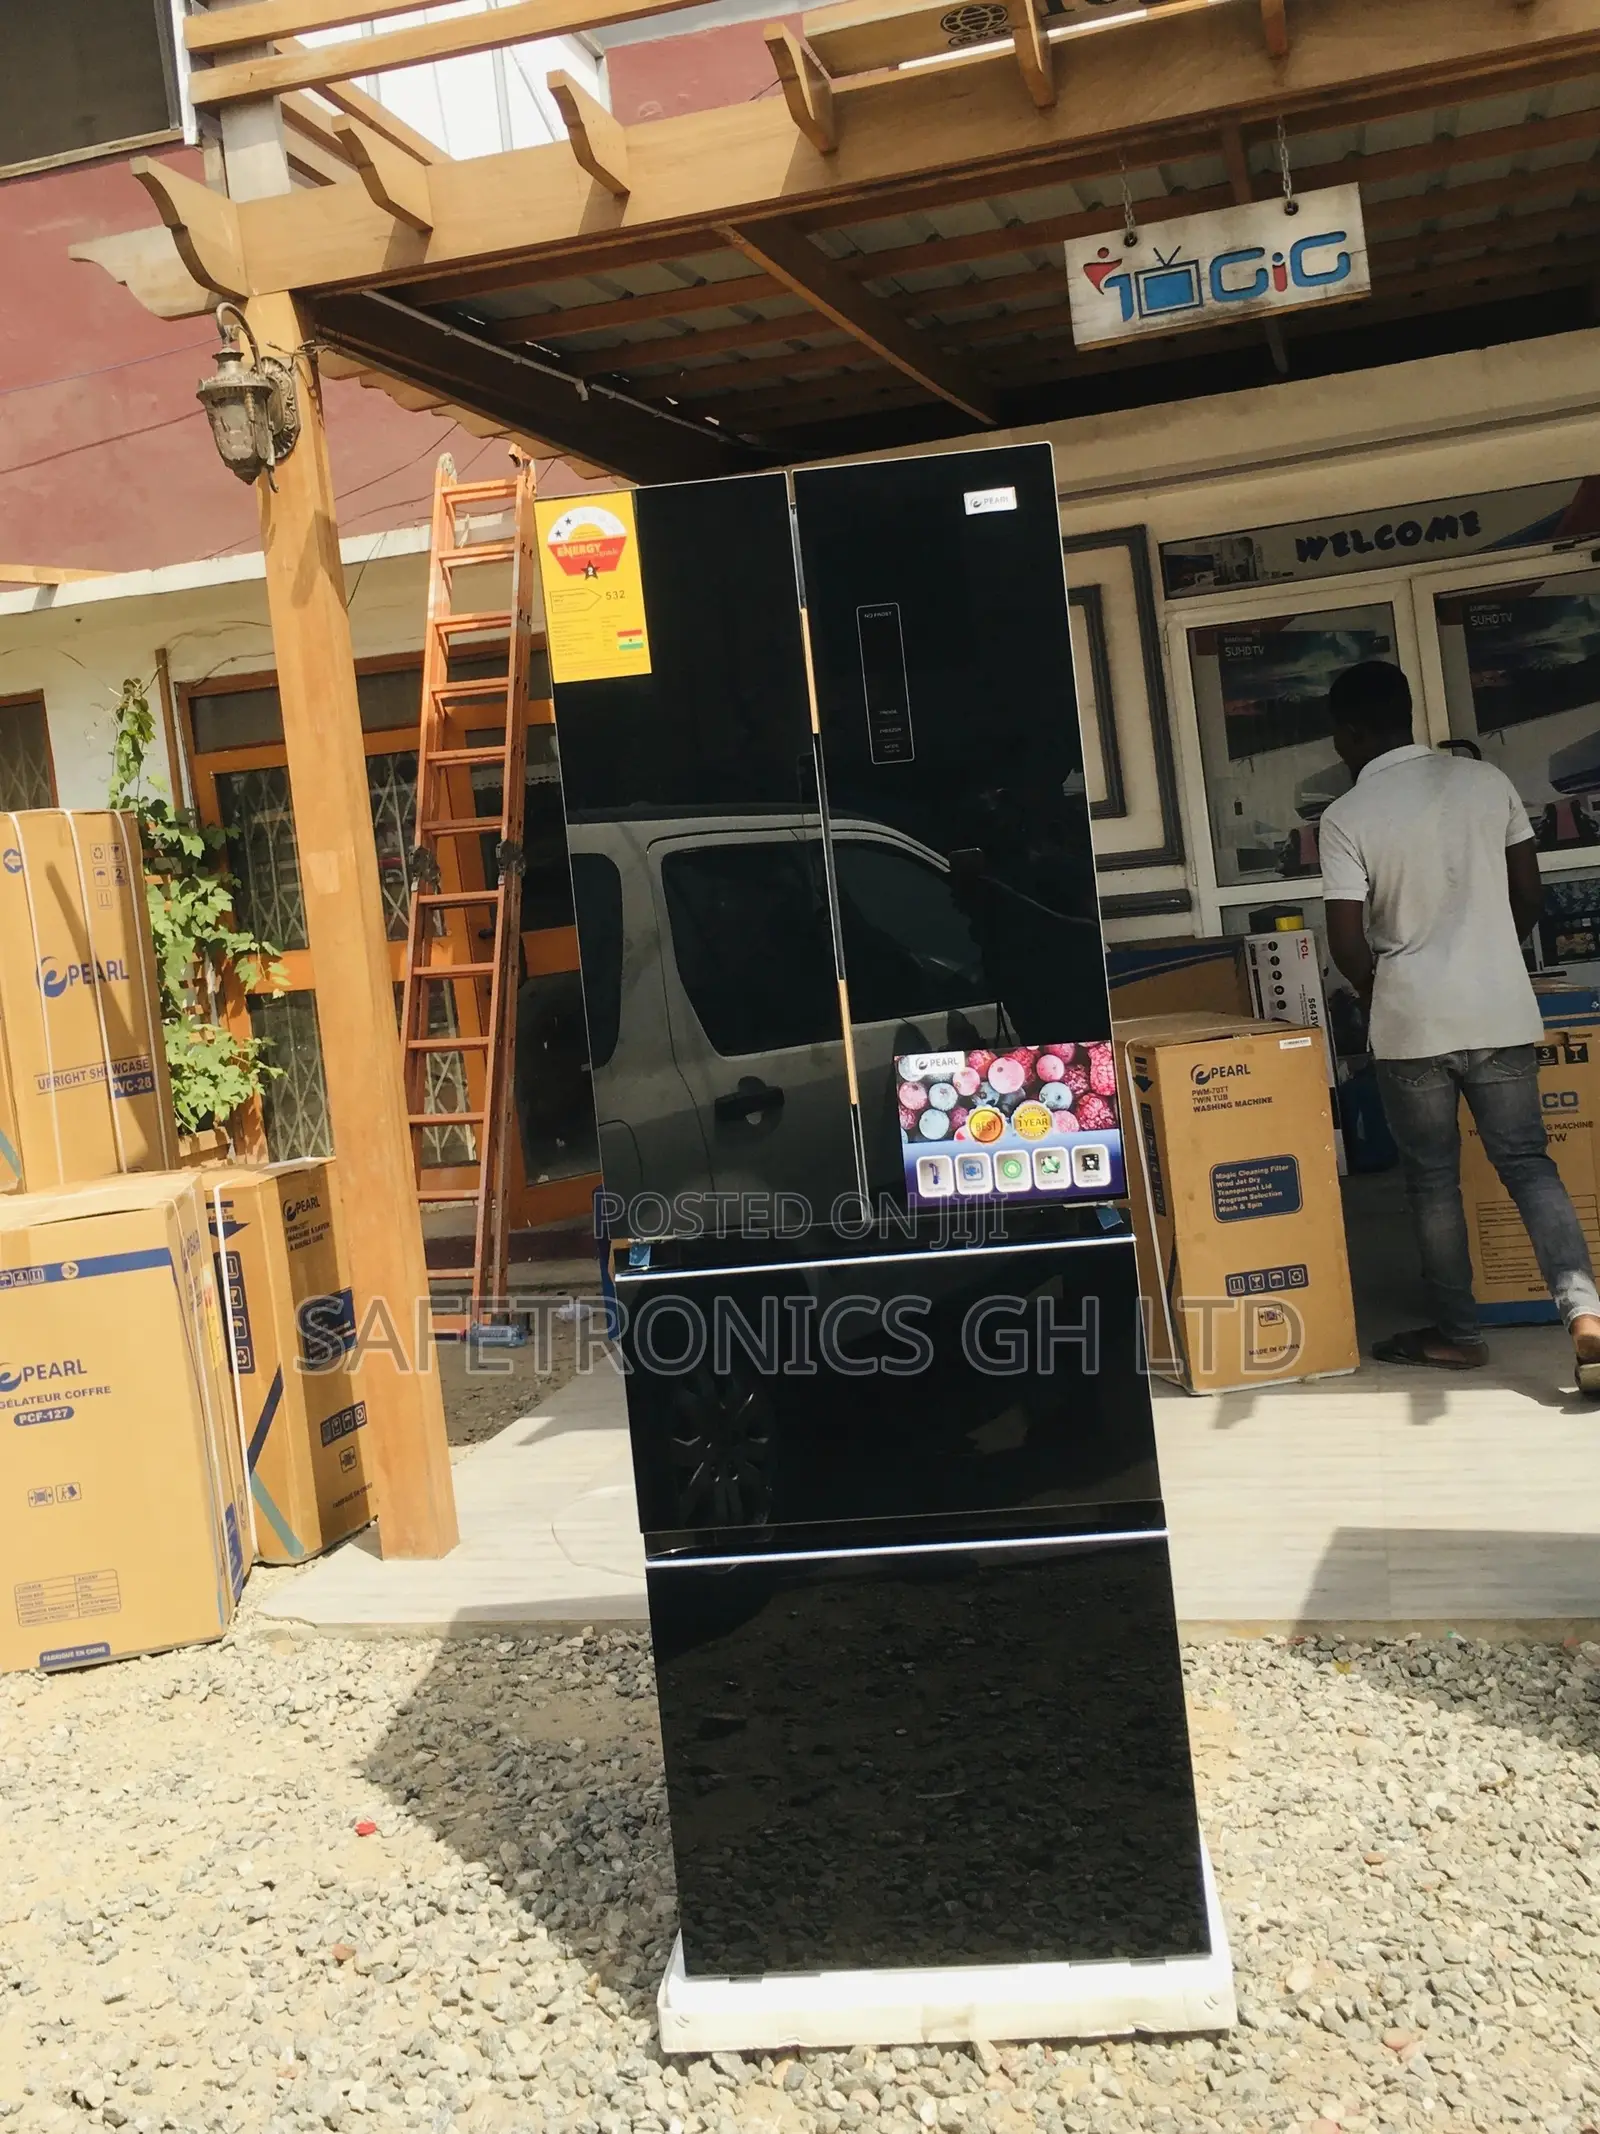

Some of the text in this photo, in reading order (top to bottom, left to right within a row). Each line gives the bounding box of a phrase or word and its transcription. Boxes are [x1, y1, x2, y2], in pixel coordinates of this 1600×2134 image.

[1295, 510, 1482, 562] WELCOME
[557, 543, 601, 558] ENERGY
[605, 589, 626, 601] 532
[1300, 937, 1309, 960] TCL
[68, 959, 130, 988] PEARL
[929, 1057, 960, 1068] PEARL
[1211, 1063, 1251, 1079] PEARL
[1191, 1094, 1229, 1105] TWIN TUB
[1193, 1096, 1273, 1113] WASHING MACHINE
[975, 1120, 997, 1132] BEST
[1023, 1118, 1048, 1127] YEAR
[1554, 1120, 1594, 1131] MACHINE
[1216, 1164, 1289, 1181] Magic Cleaning Filter
[1216, 1179, 1234, 1188] Wind
[1249, 1175, 1261, 1185] Dry
[1217, 1182, 1273, 1197] Transparent Lid
[295, 1196, 321, 1215] PEARL
[1218, 1190, 1283, 1206] Program Selection
[1219, 1204, 1238, 1214] Wash
[22, 1358, 88, 1382] PEARL
[65, 1385, 112, 1400] COFFRE
[19, 1407, 69, 1425] PCF-127
